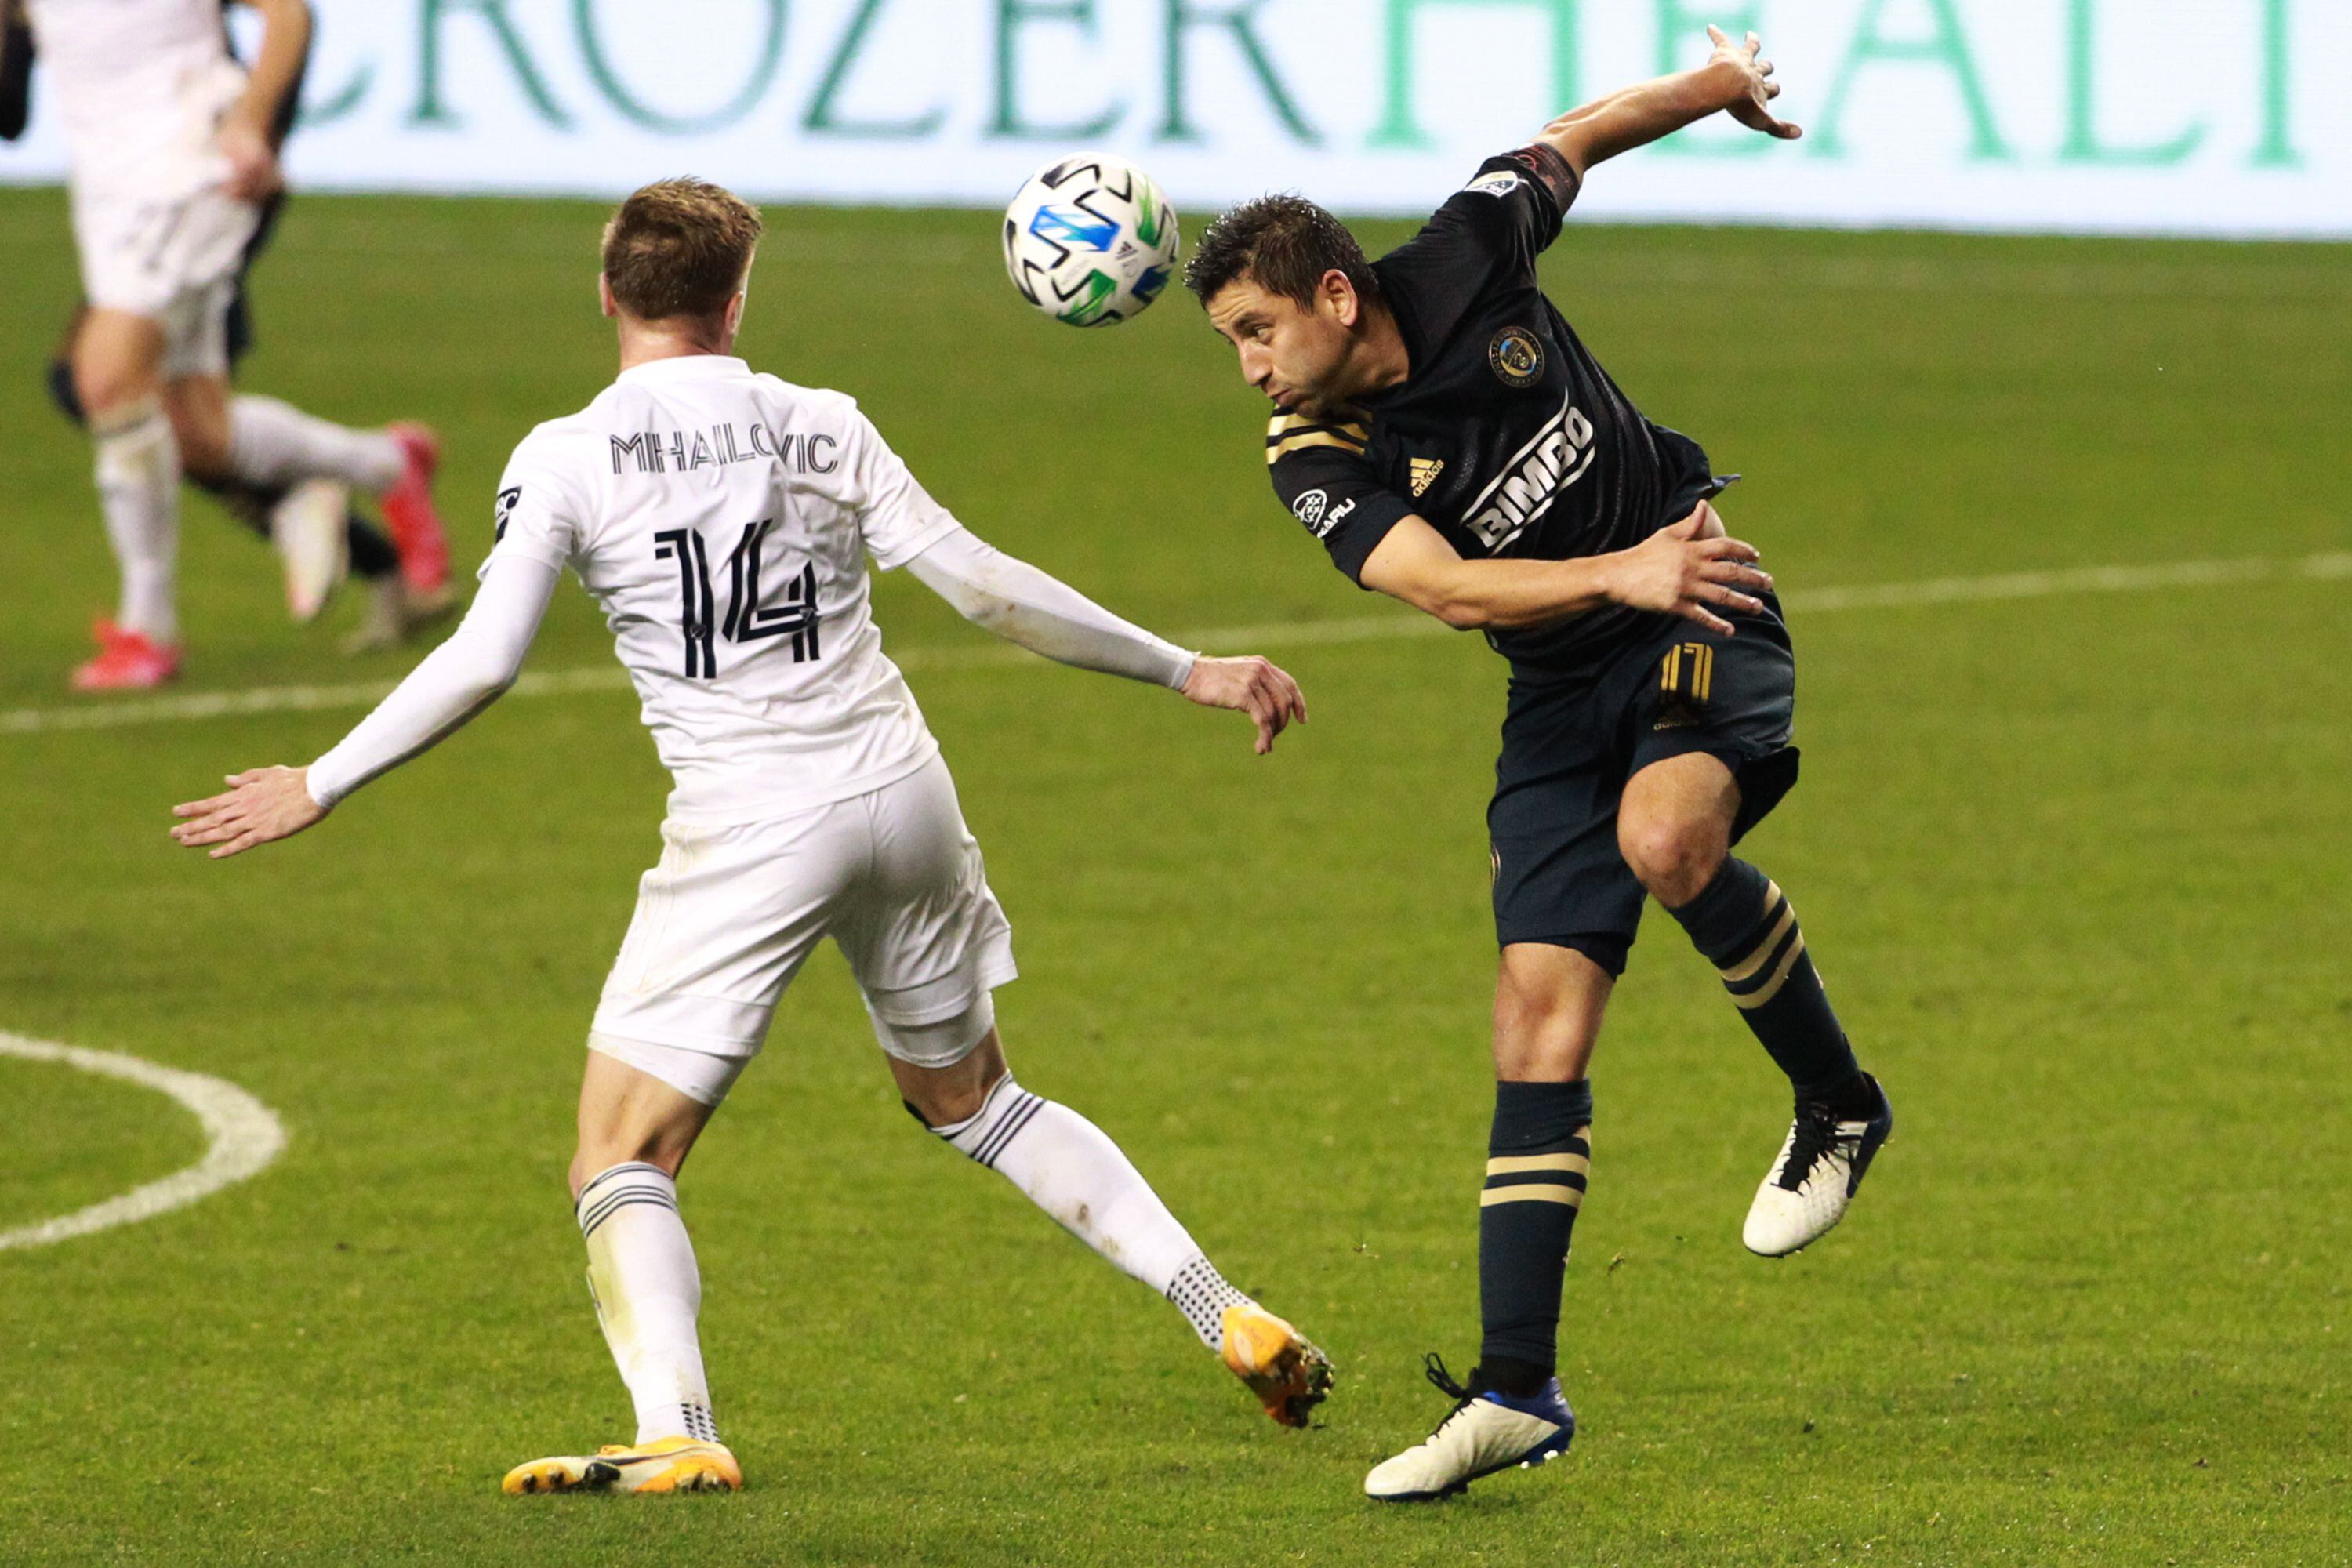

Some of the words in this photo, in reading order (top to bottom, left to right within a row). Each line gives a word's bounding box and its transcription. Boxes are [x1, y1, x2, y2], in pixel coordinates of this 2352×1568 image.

[1412, 459, 1445, 498] adidas
[1466, 406, 1594, 548] BIMBO
[654, 517, 822, 679] 14
[1661, 641, 1714, 703] 17
